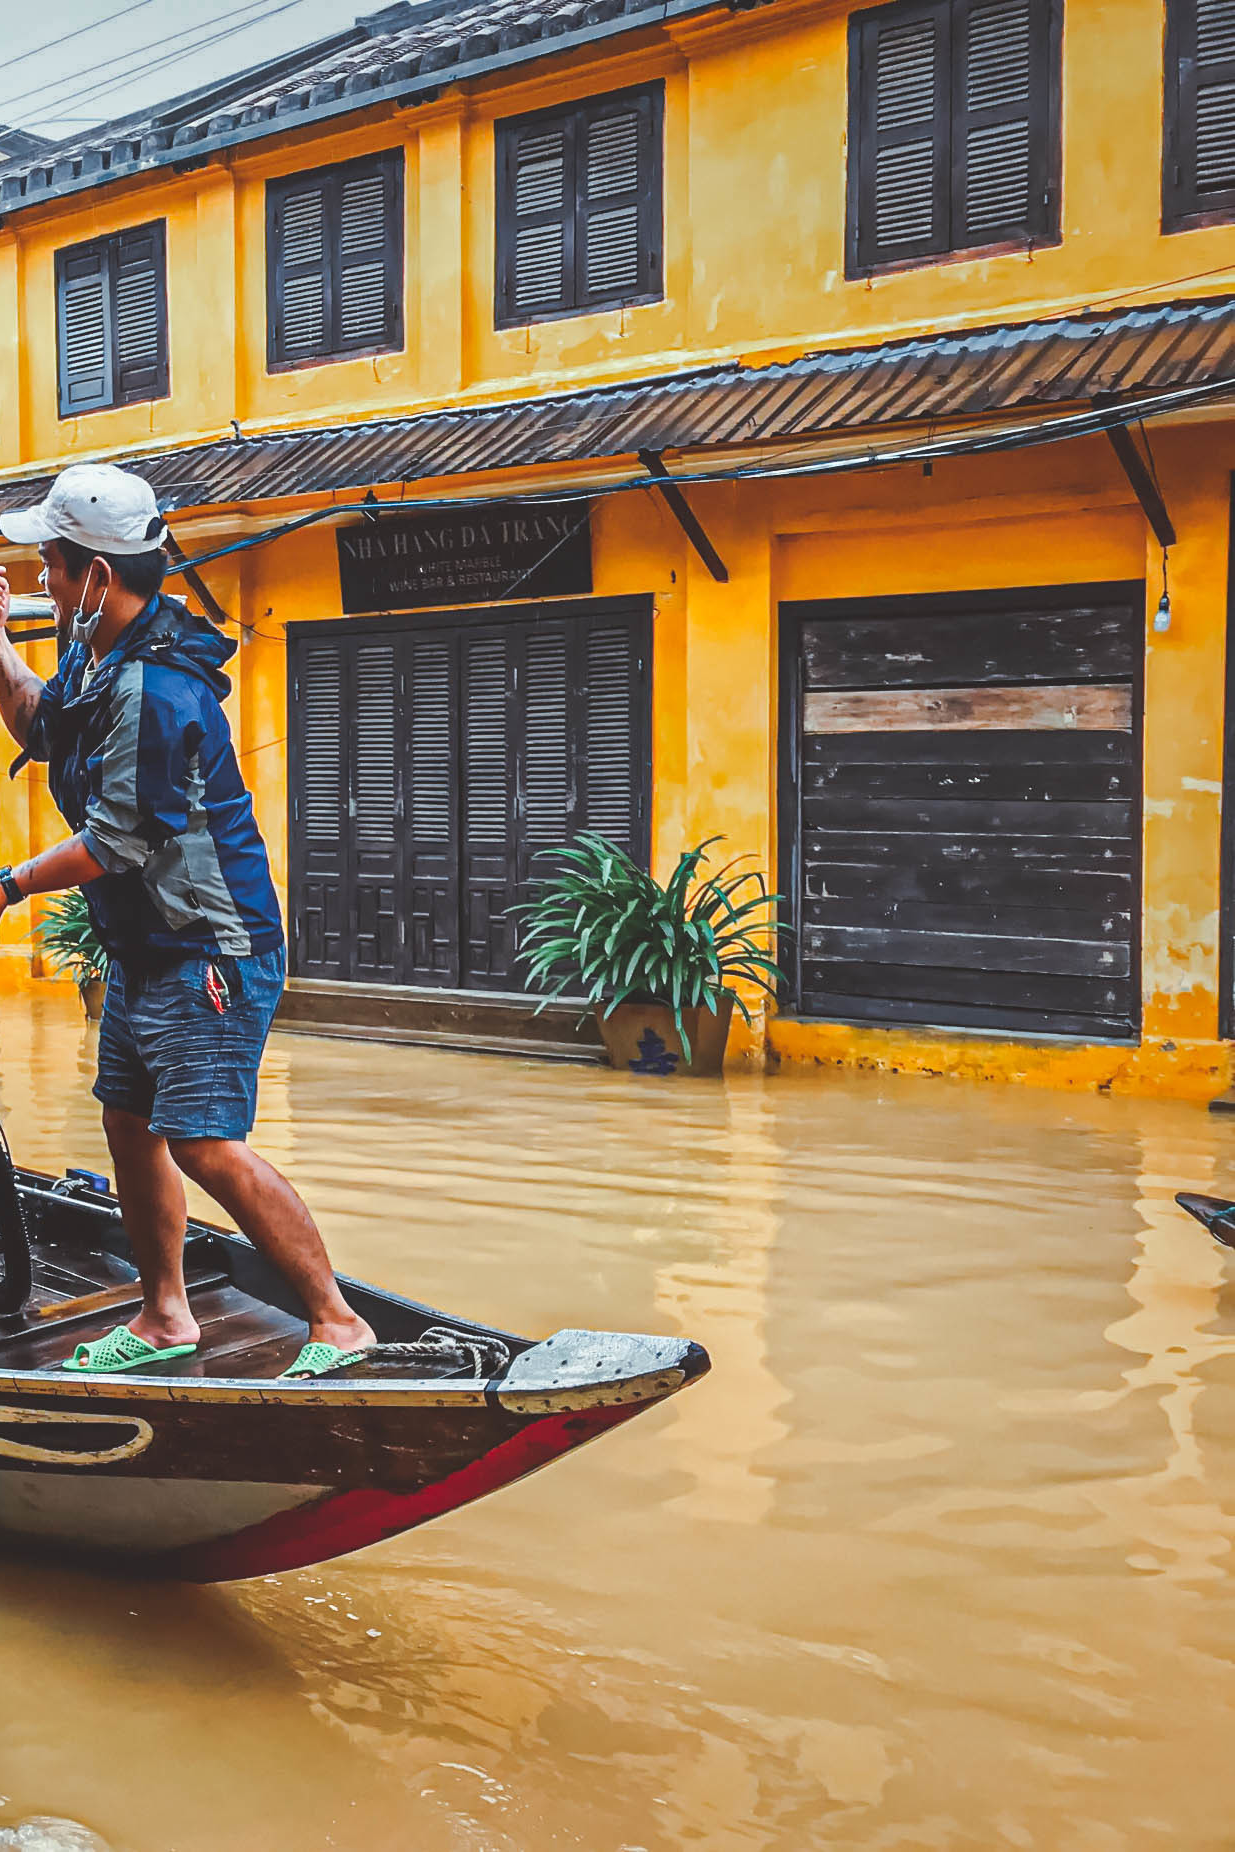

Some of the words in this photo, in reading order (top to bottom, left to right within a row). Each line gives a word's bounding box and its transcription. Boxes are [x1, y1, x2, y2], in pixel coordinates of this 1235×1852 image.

[418, 560, 452, 574] WHITE
[455, 556, 502, 570] MARBLE
[389, 577, 418, 592] WINE
[421, 576, 444, 589] BAR
[445, 574, 455, 587] &
[458, 568, 532, 585] RESTAURANT
